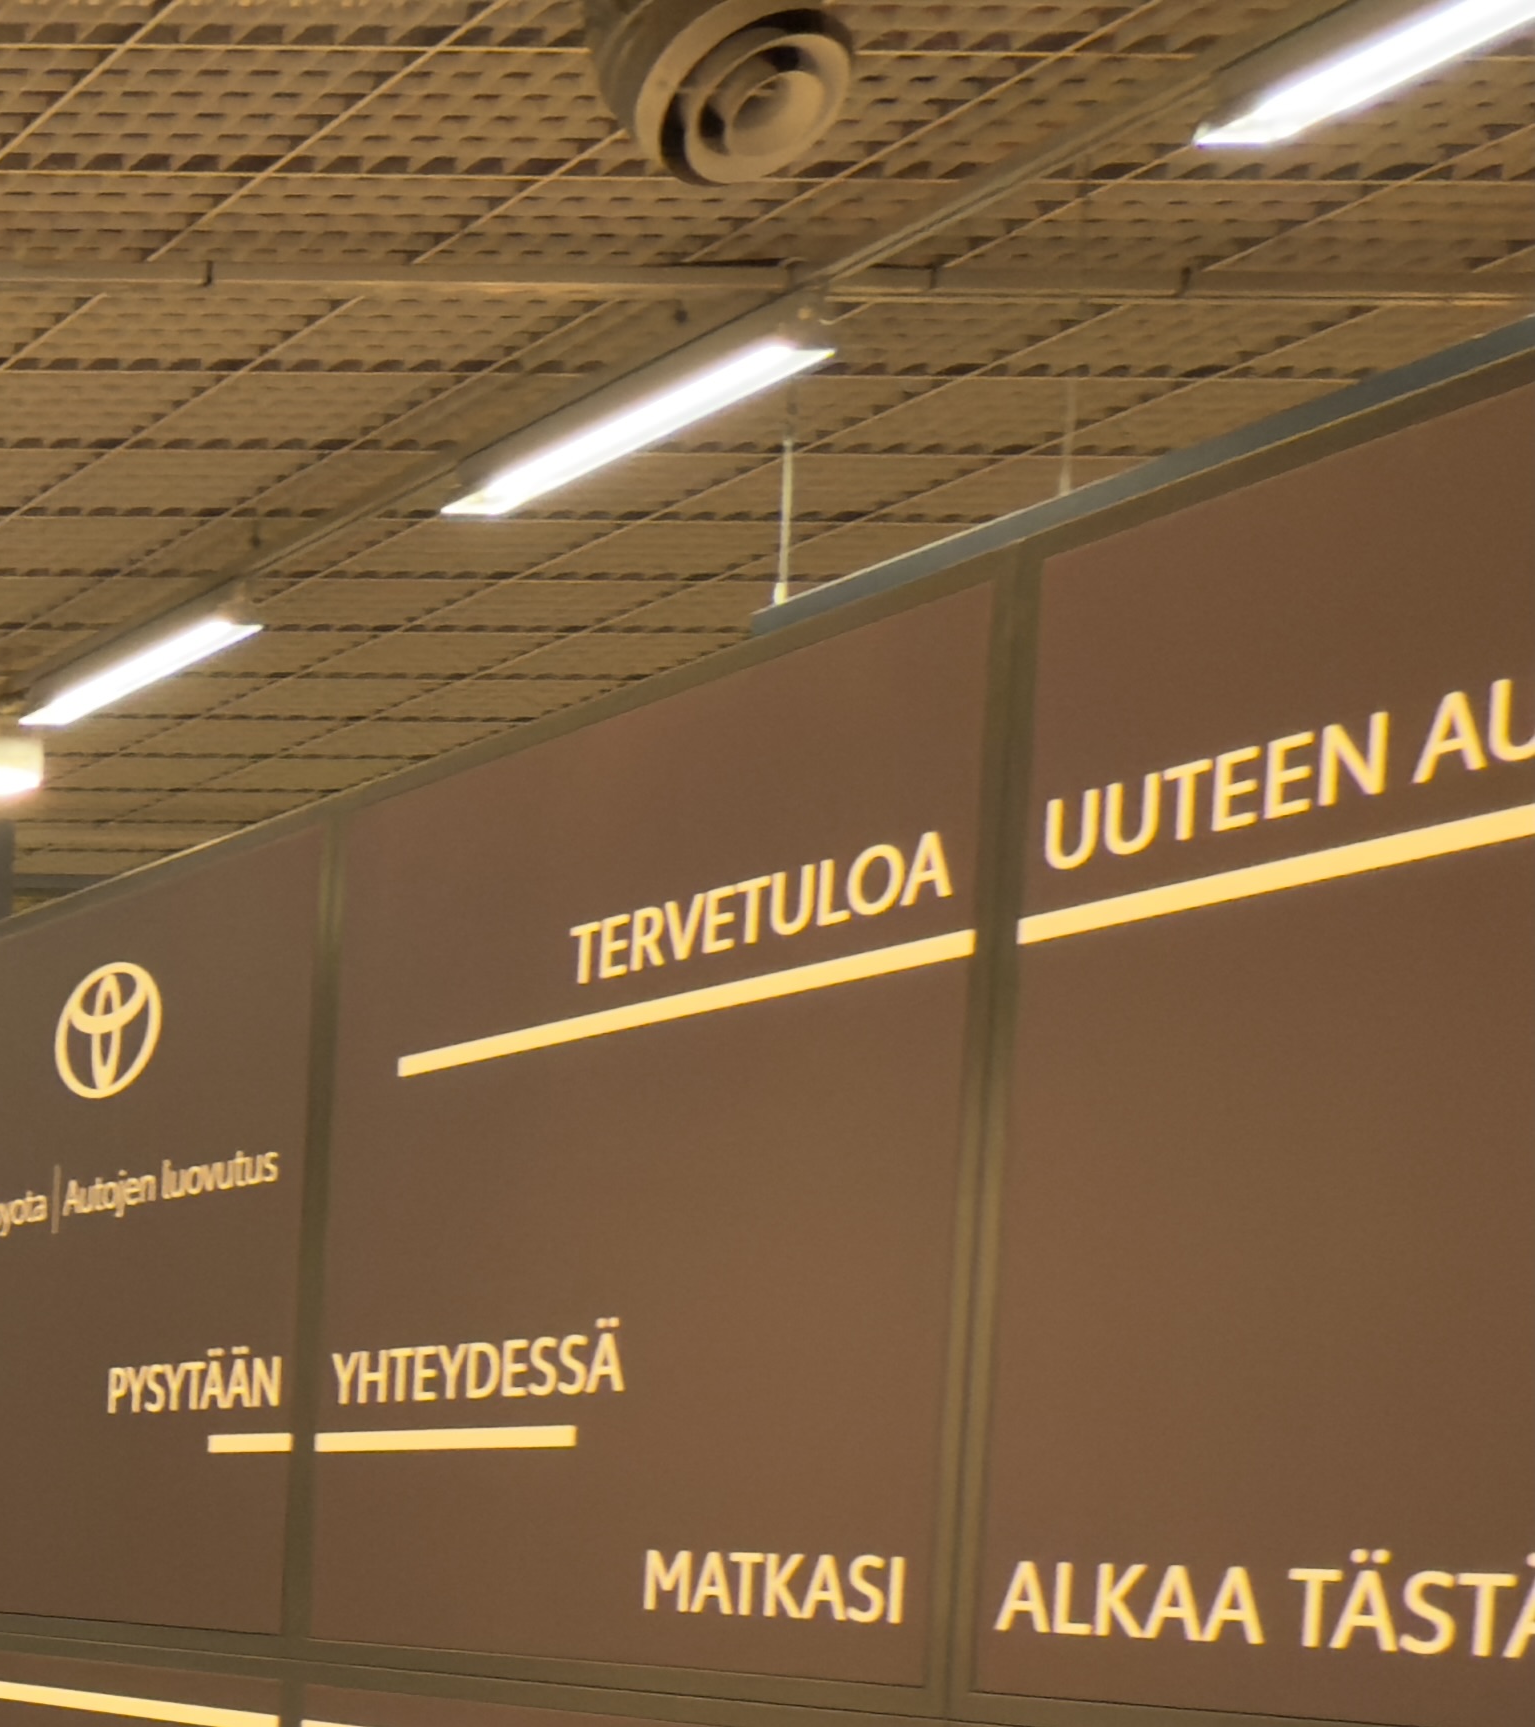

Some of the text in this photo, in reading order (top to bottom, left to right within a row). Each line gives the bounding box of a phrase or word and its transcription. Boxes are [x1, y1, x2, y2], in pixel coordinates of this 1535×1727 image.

[569, 831, 953, 985] TERVETULOA
[1044, 711, 1389, 870] UUTEEN
[62, 1170, 157, 1218] Autojen
[161, 1150, 280, 1200] luovutus
[107, 1317, 625, 1414] PYSYTÄÄN YHTEYDESSÄ
[643, 1550, 905, 1624] MATKASI
[994, 1561, 1264, 1645] ALKAA
